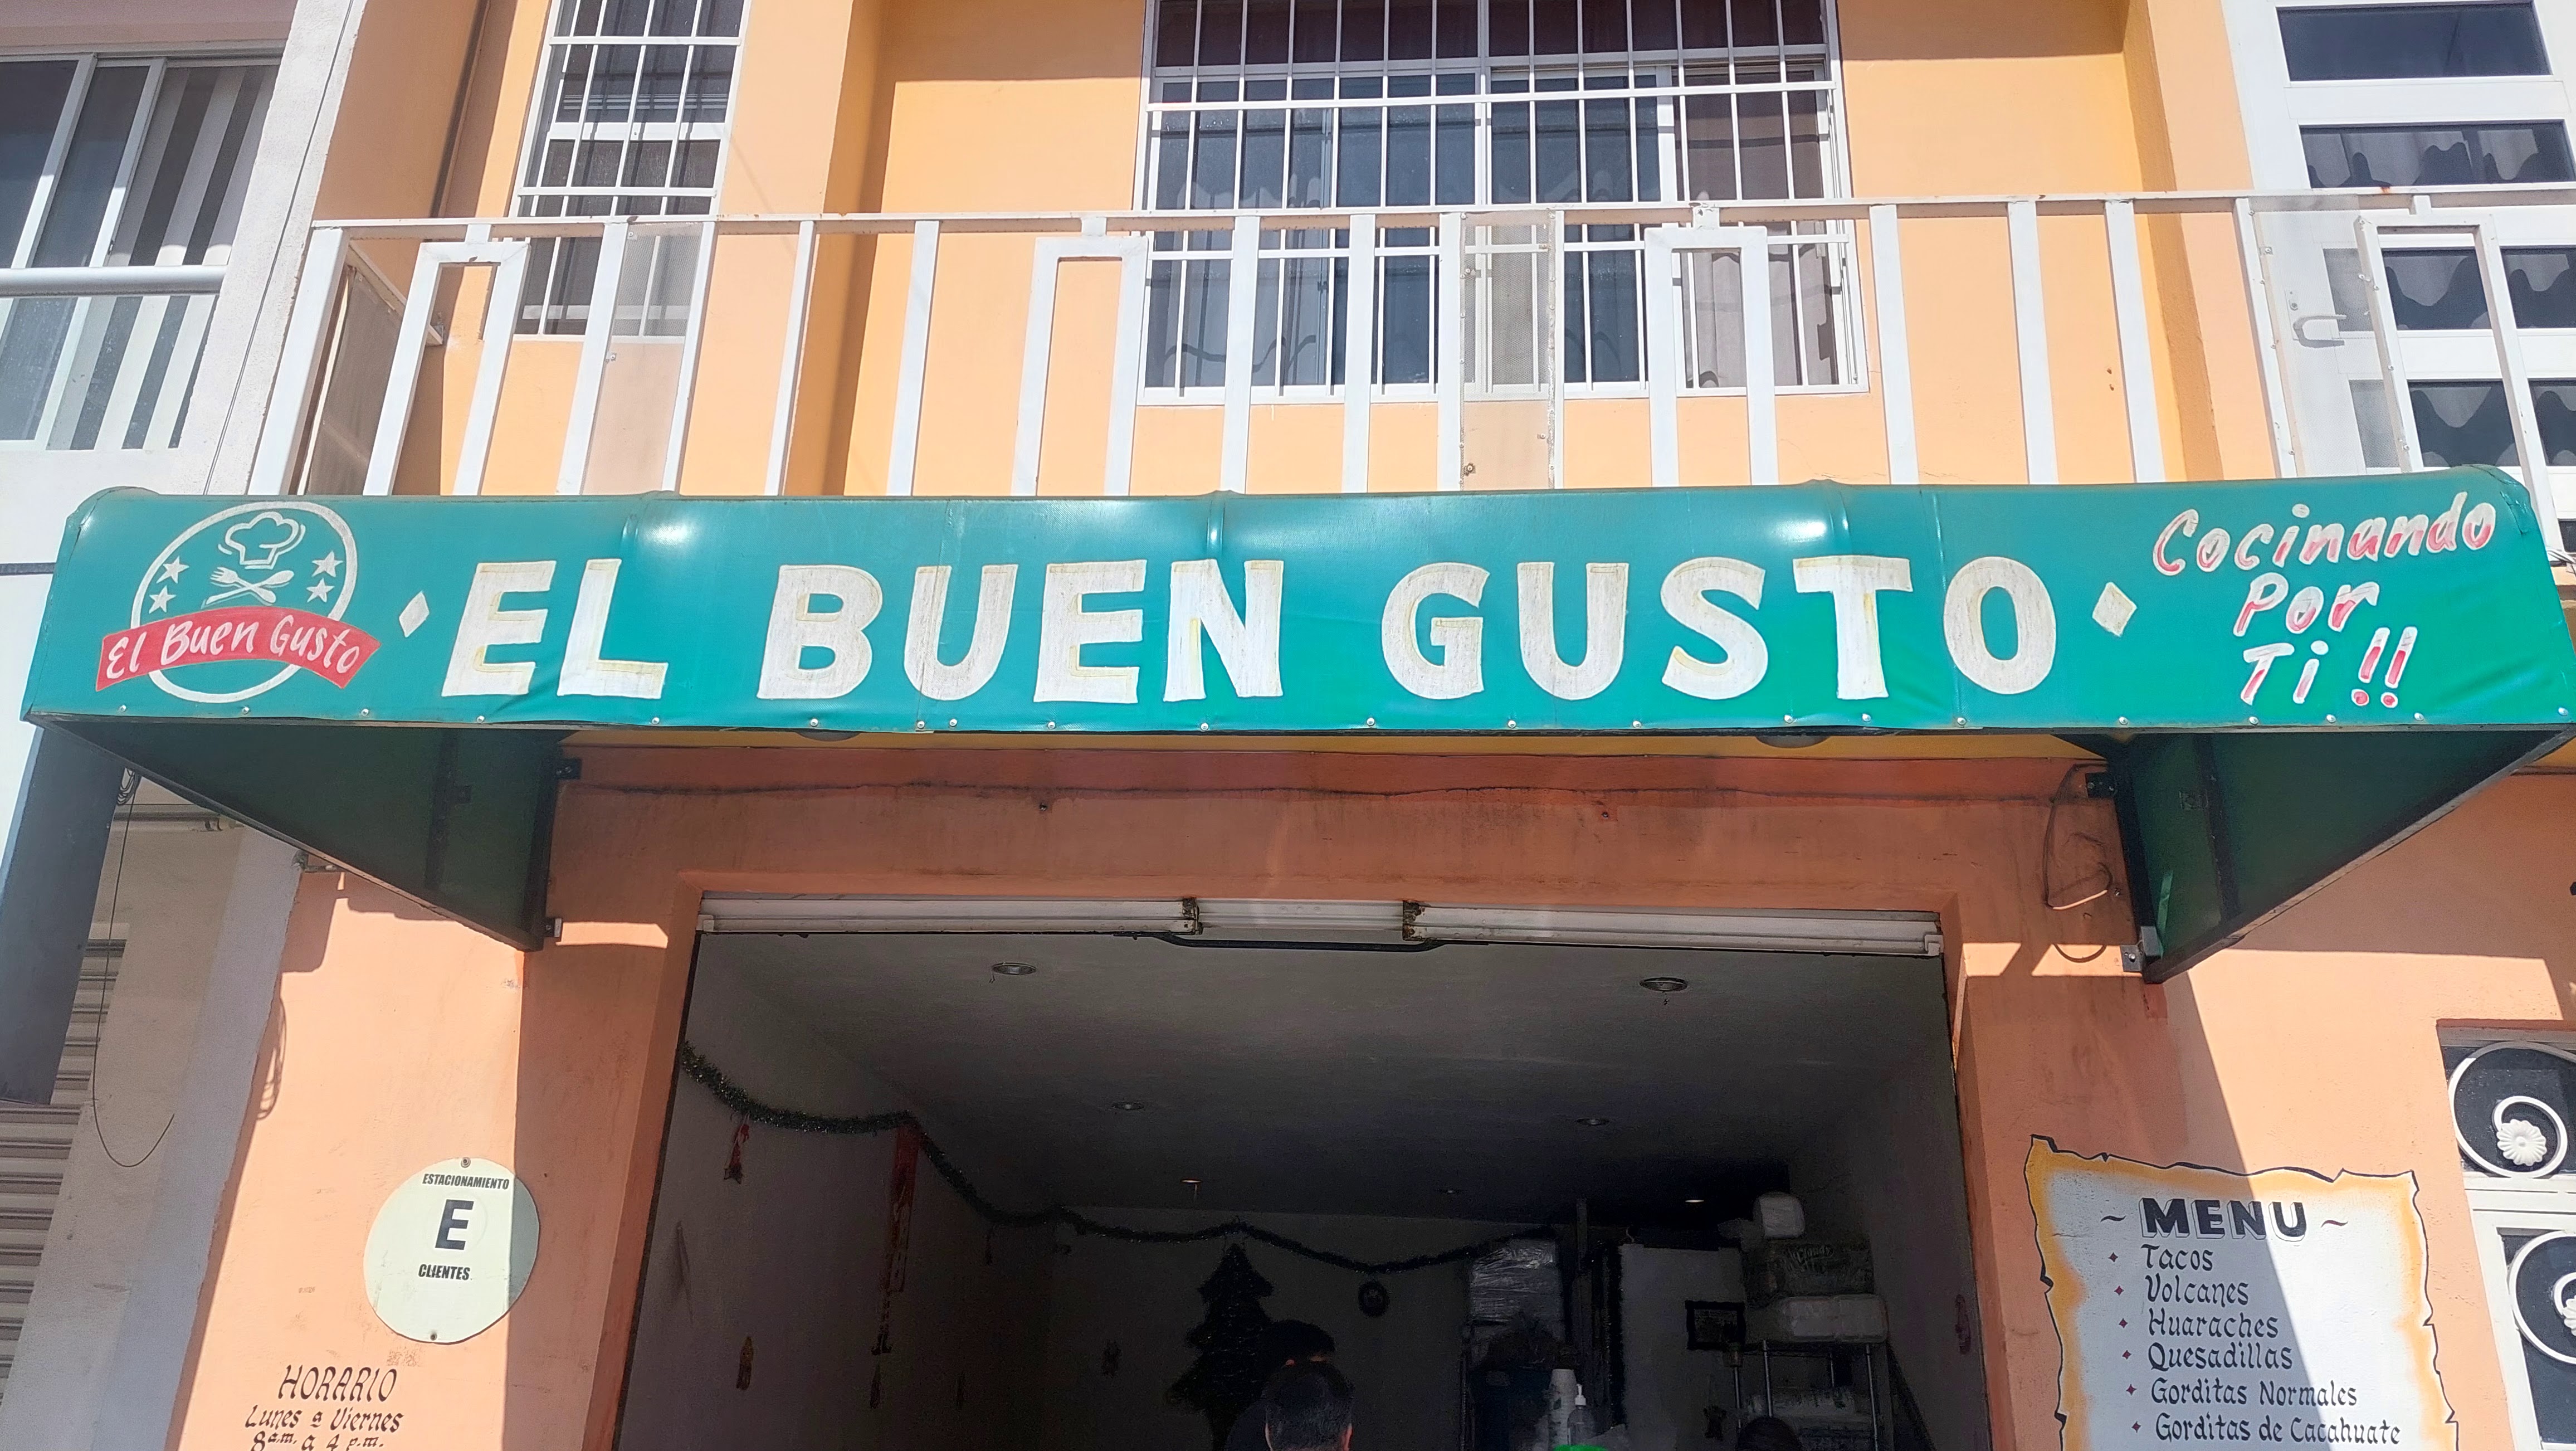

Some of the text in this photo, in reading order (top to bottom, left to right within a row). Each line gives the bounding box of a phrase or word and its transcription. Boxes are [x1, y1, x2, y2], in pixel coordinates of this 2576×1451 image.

[2153, 491, 2496, 576] Cocinando
[2232, 572, 2380, 637] Por
[106, 614, 360, 679] El Buen Gusto
[442, 555, 2057, 704] EL BUEN GUSTO
[2240, 640, 2329, 706] Ti
[422, 1173, 510, 1190] ESTACIONAMIENTO
[435, 1199, 475, 1250] E
[2139, 1197, 2307, 1242] MENU
[418, 1263, 471, 1281] CLIENTES
[2140, 1244, 2214, 1271] Tacos
[2145, 1273, 2250, 1308] Volcanes
[2148, 1307, 2279, 1338] Huaraches
[2148, 1341, 2294, 1372] Quesadillas
[277, 1365, 397, 1403] HORARIO
[2151, 1376, 2358, 1407] Gorditas Normales
[245, 1404, 303, 1430] Lunes
[330, 1406, 404, 1433] Viernes
[2155, 1411, 2401, 1445] Gorditas de Cacahuate
[301, 1434, 316, 1451] a
